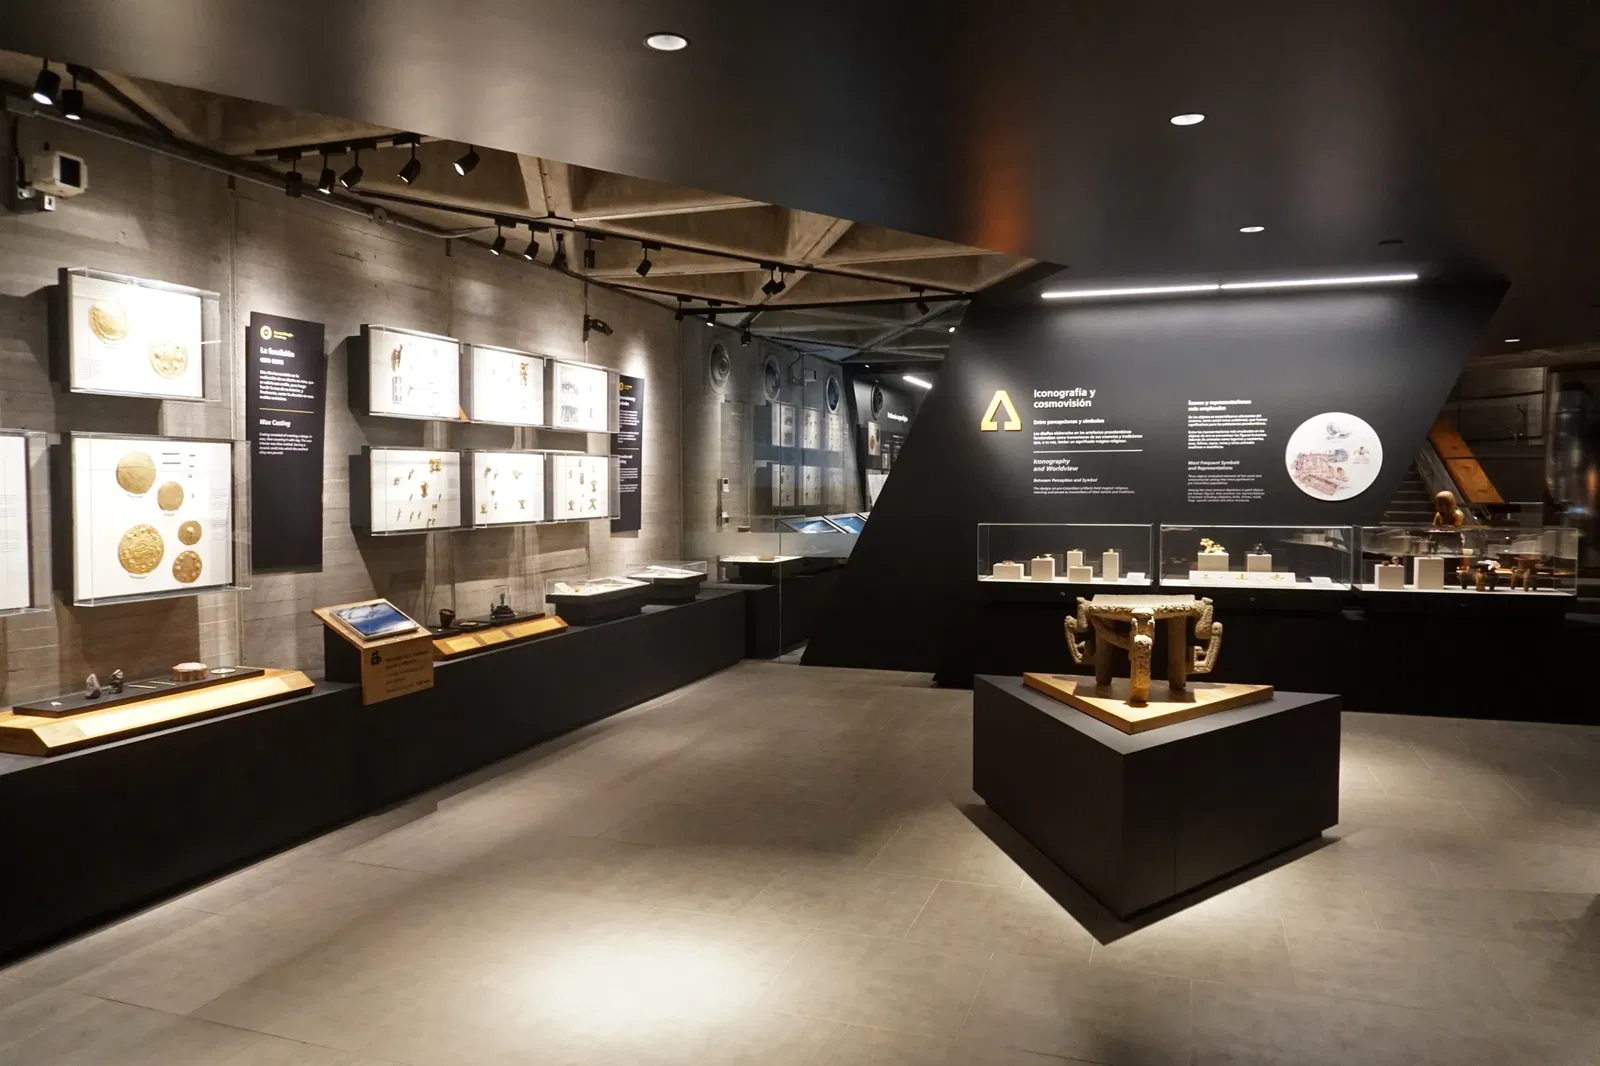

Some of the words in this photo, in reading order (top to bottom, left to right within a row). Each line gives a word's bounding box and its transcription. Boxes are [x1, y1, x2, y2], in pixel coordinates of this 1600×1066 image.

[1033, 387, 1088, 399] Iconografía
[1089, 389, 1096, 399] y
[1033, 399, 1092, 408] cosmovisión
[272, 419, 292, 428] Casting
[1033, 458, 1070, 466] Iconography
